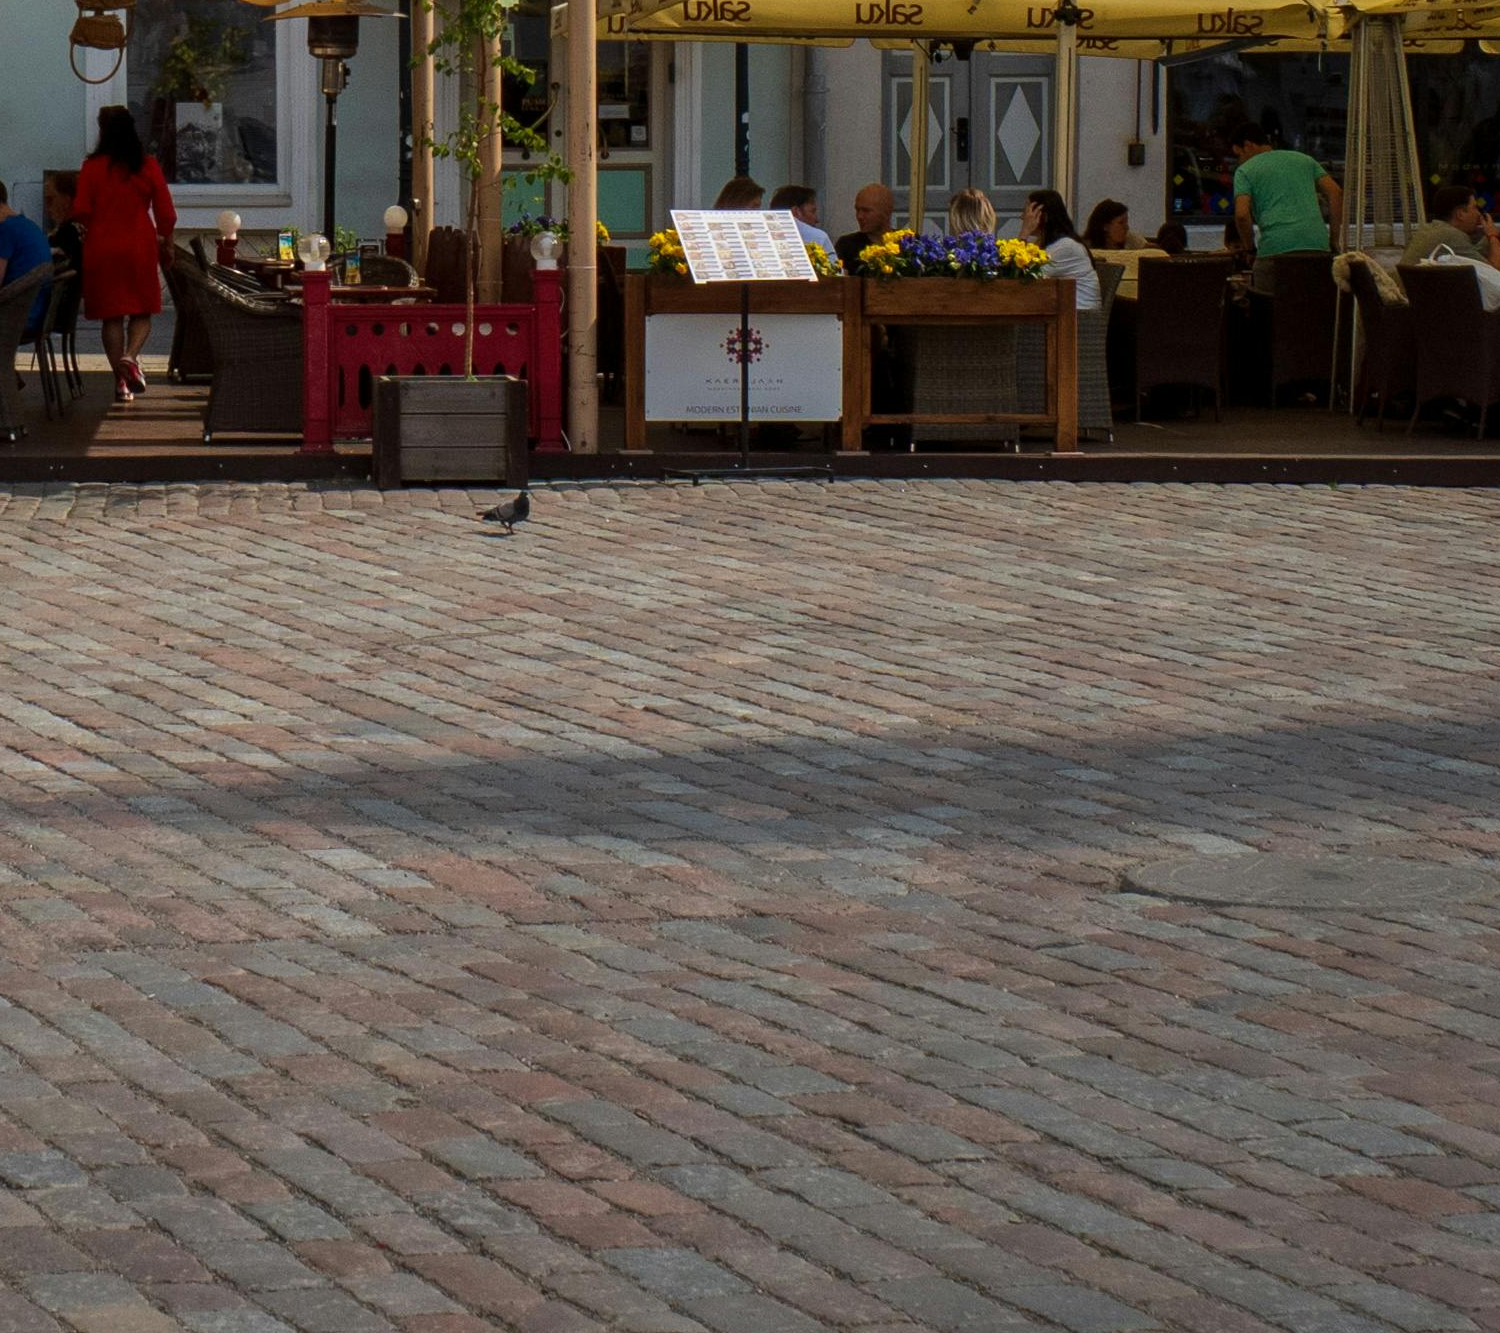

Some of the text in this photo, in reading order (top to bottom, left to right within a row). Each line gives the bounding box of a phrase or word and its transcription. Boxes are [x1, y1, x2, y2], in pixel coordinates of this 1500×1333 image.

[686, 405, 803, 415] MODERN ESTNIAN CUISINE
